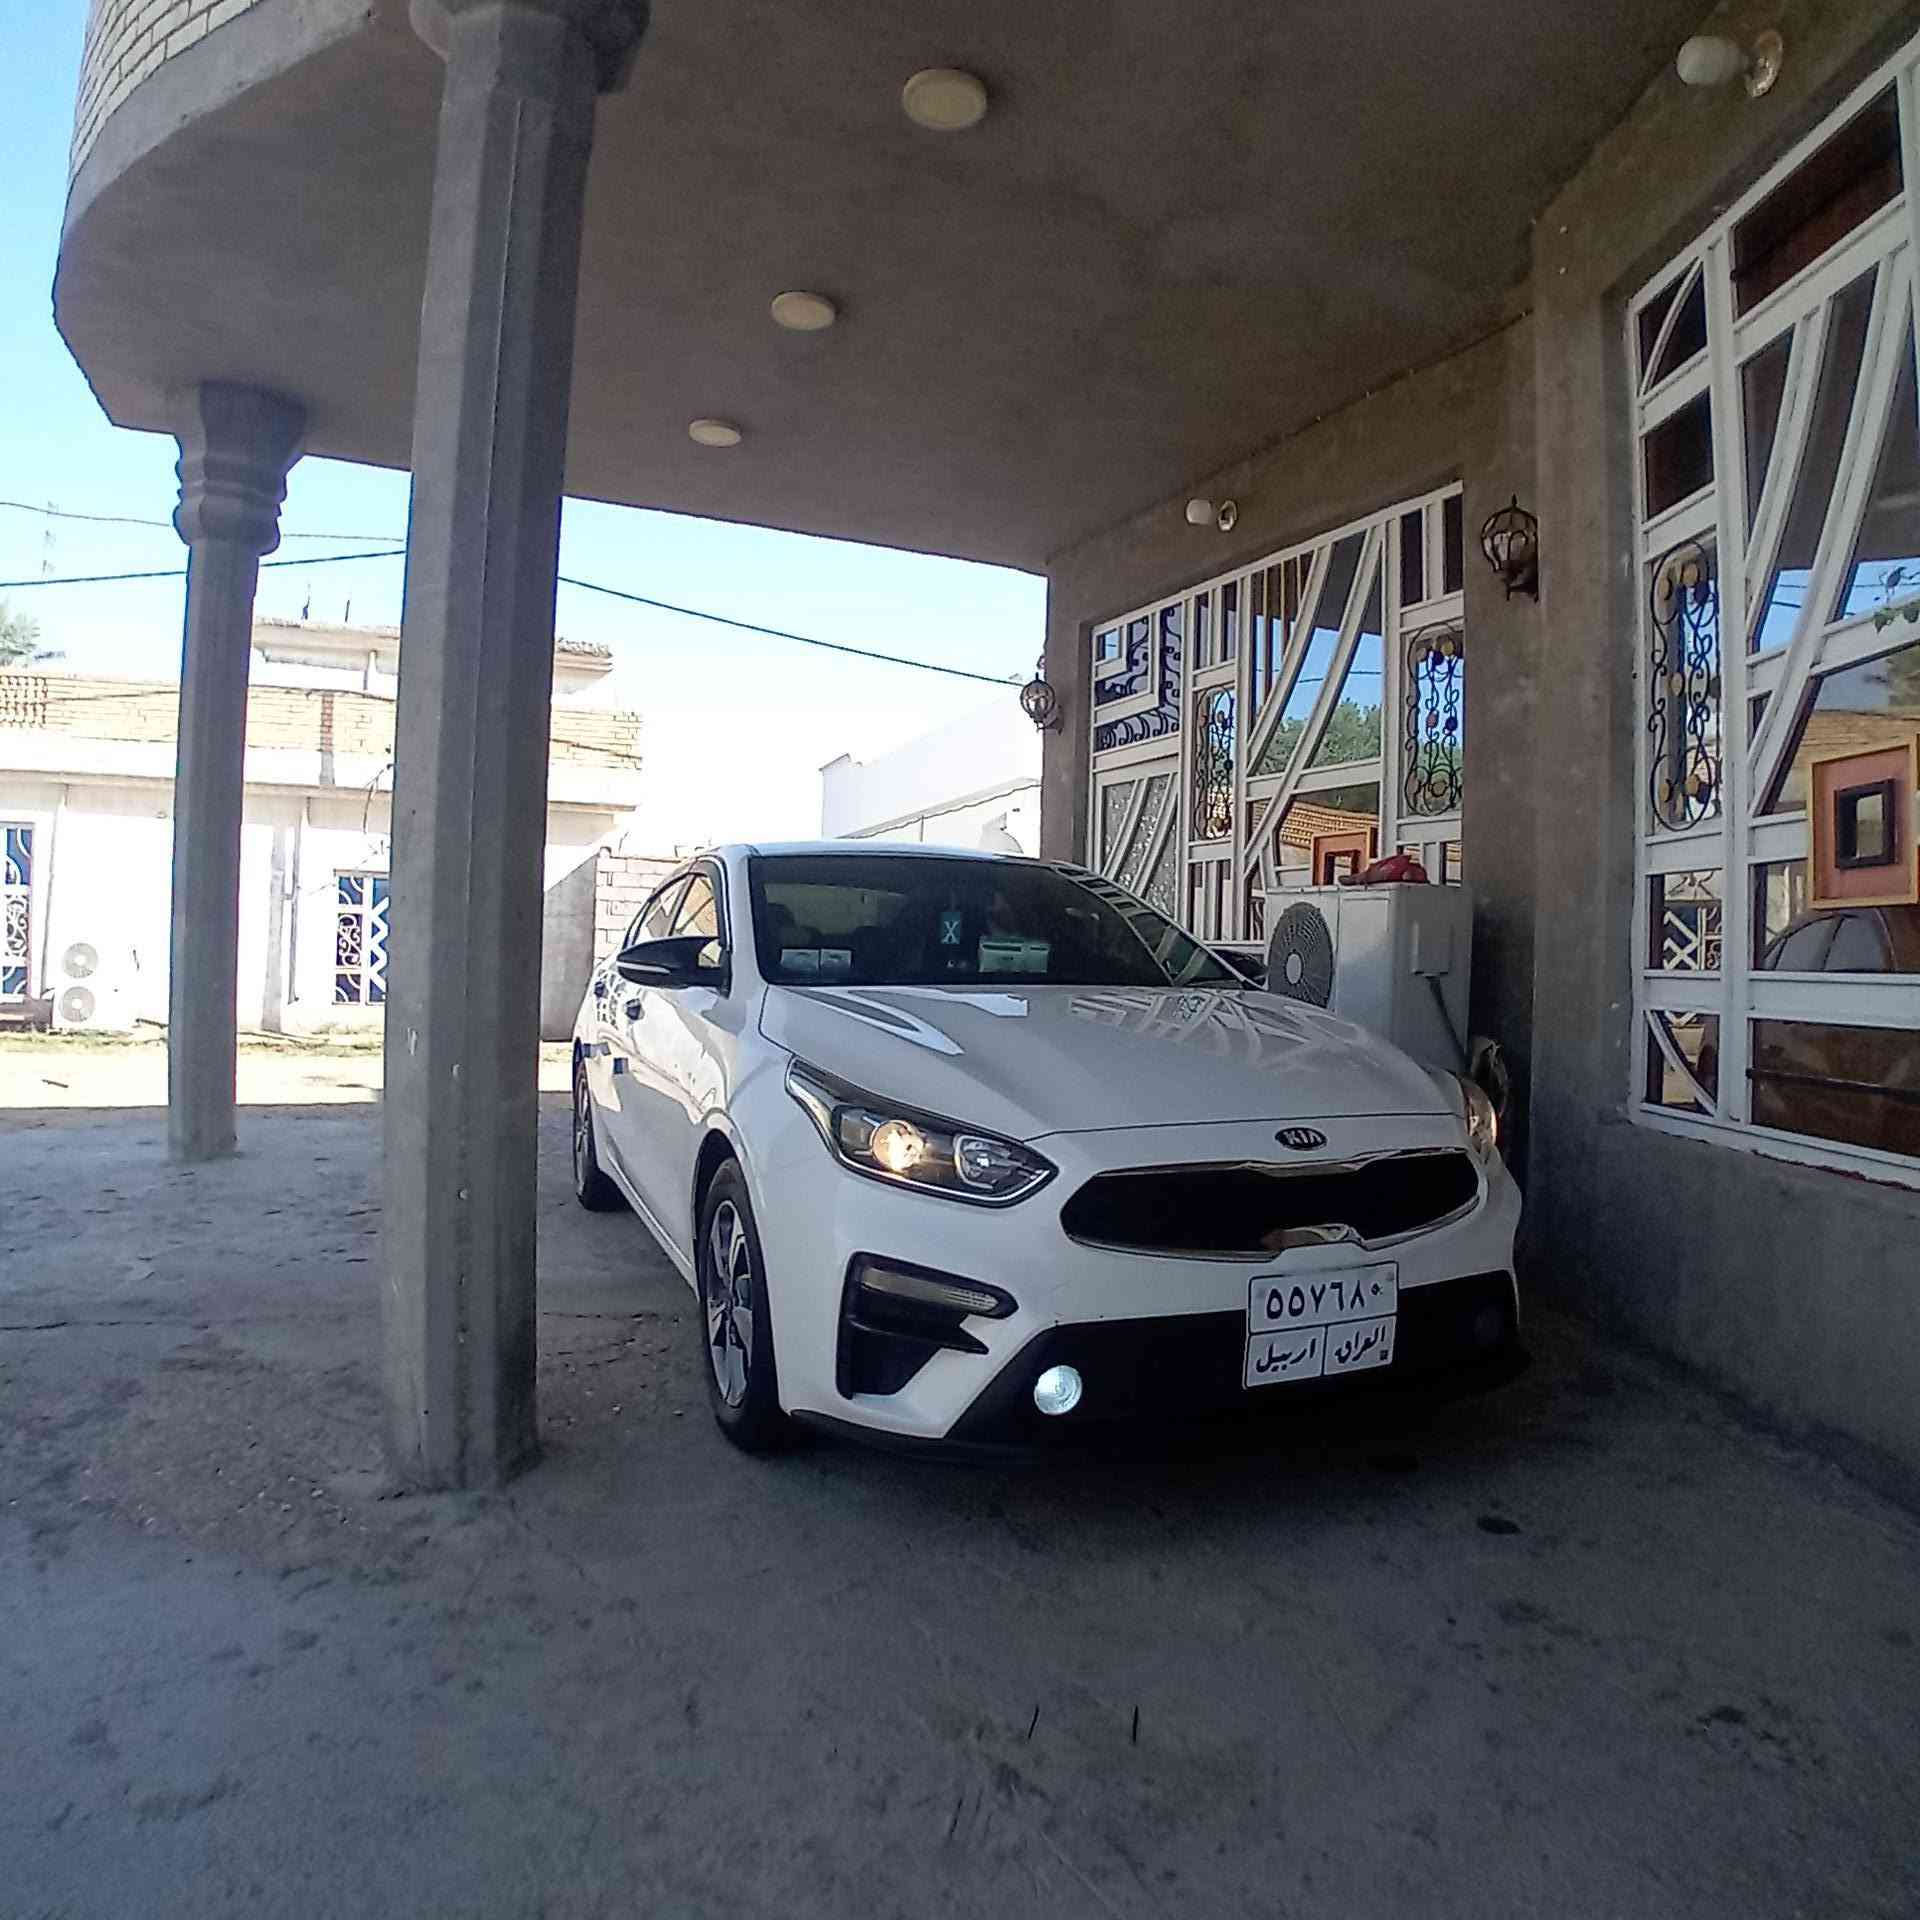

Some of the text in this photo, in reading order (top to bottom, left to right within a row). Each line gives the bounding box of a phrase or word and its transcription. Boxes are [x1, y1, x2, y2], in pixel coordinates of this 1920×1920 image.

[1282, 1129, 1322, 1145] KIA
[1255, 1337, 1317, 1373] اربيل
[1334, 1324, 1386, 1364] العراق
